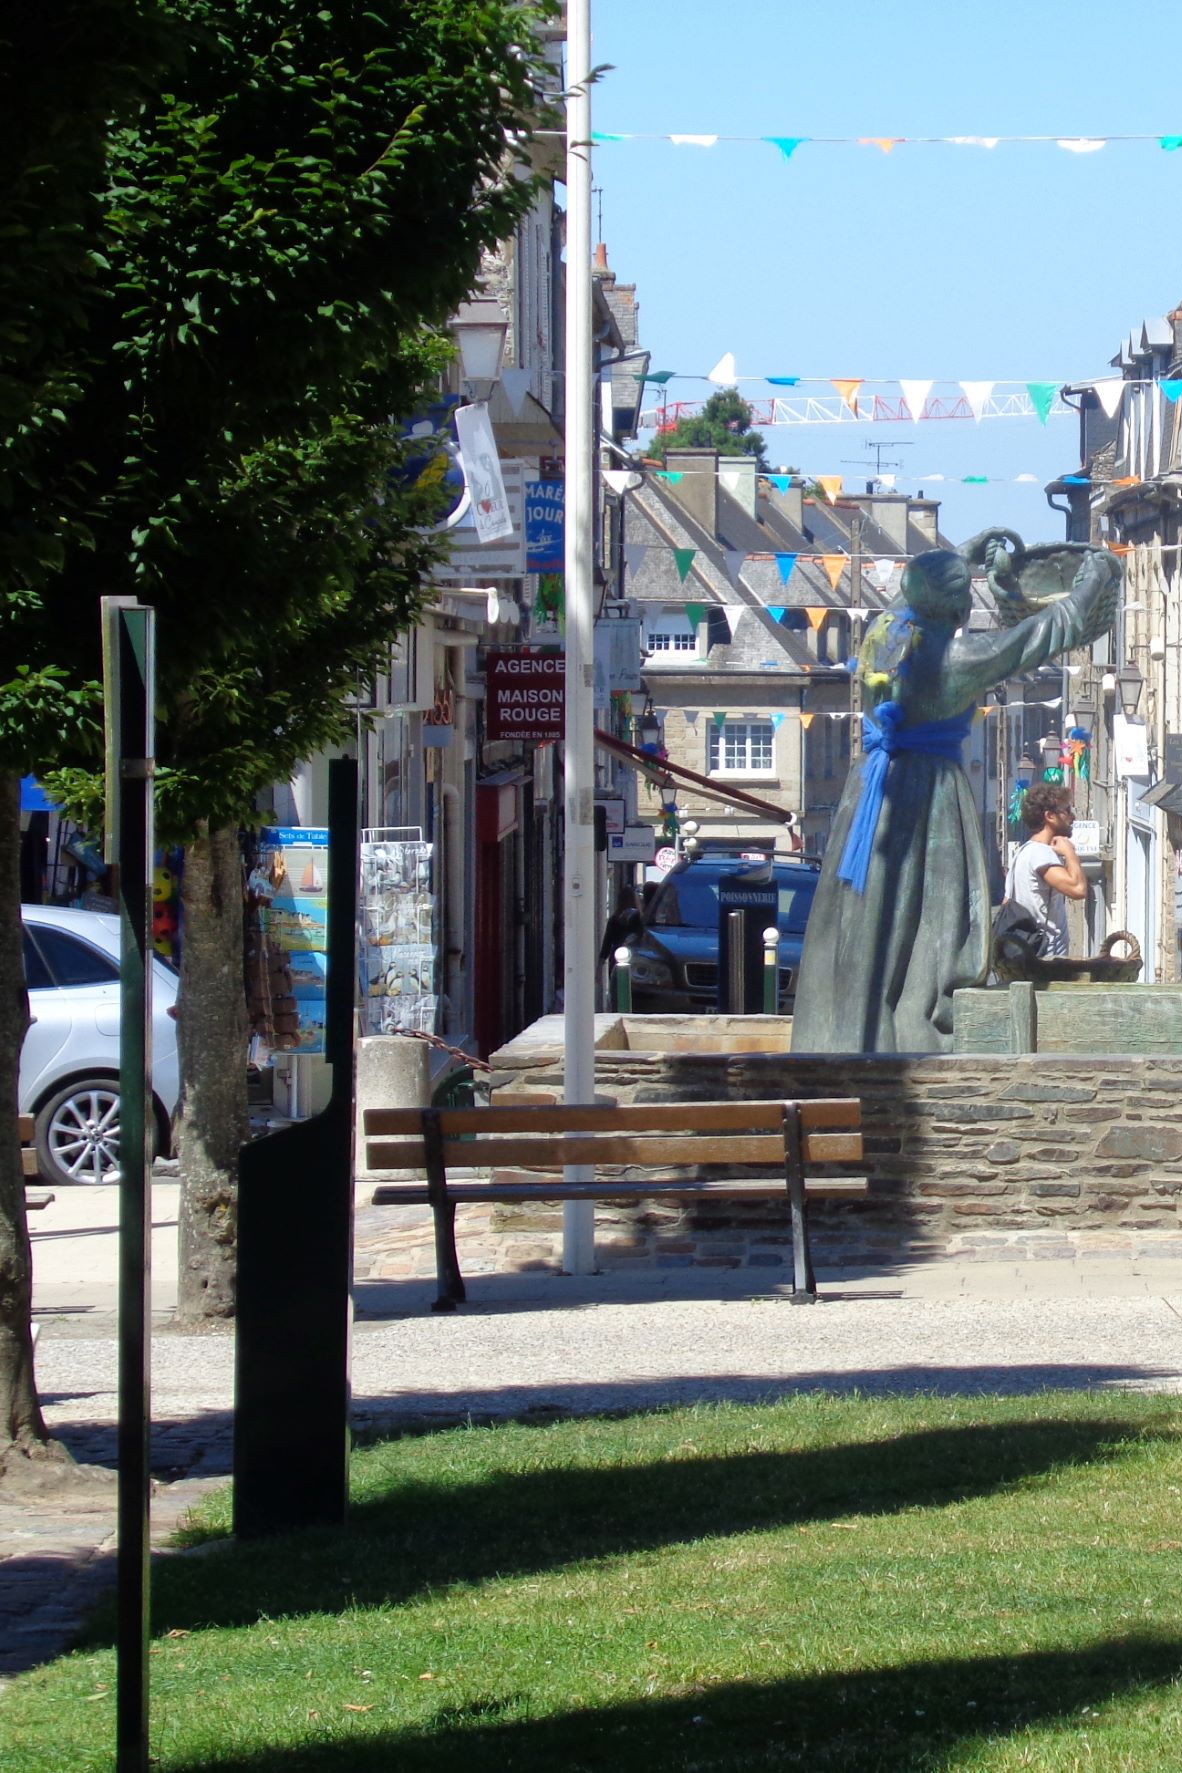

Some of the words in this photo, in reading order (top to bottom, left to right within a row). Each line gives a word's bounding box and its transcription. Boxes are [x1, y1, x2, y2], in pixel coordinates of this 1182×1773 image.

[495, 659, 566, 673] AGENCE
[497, 689, 563, 703] MAISON
[500, 707, 561, 721] ROUGE
